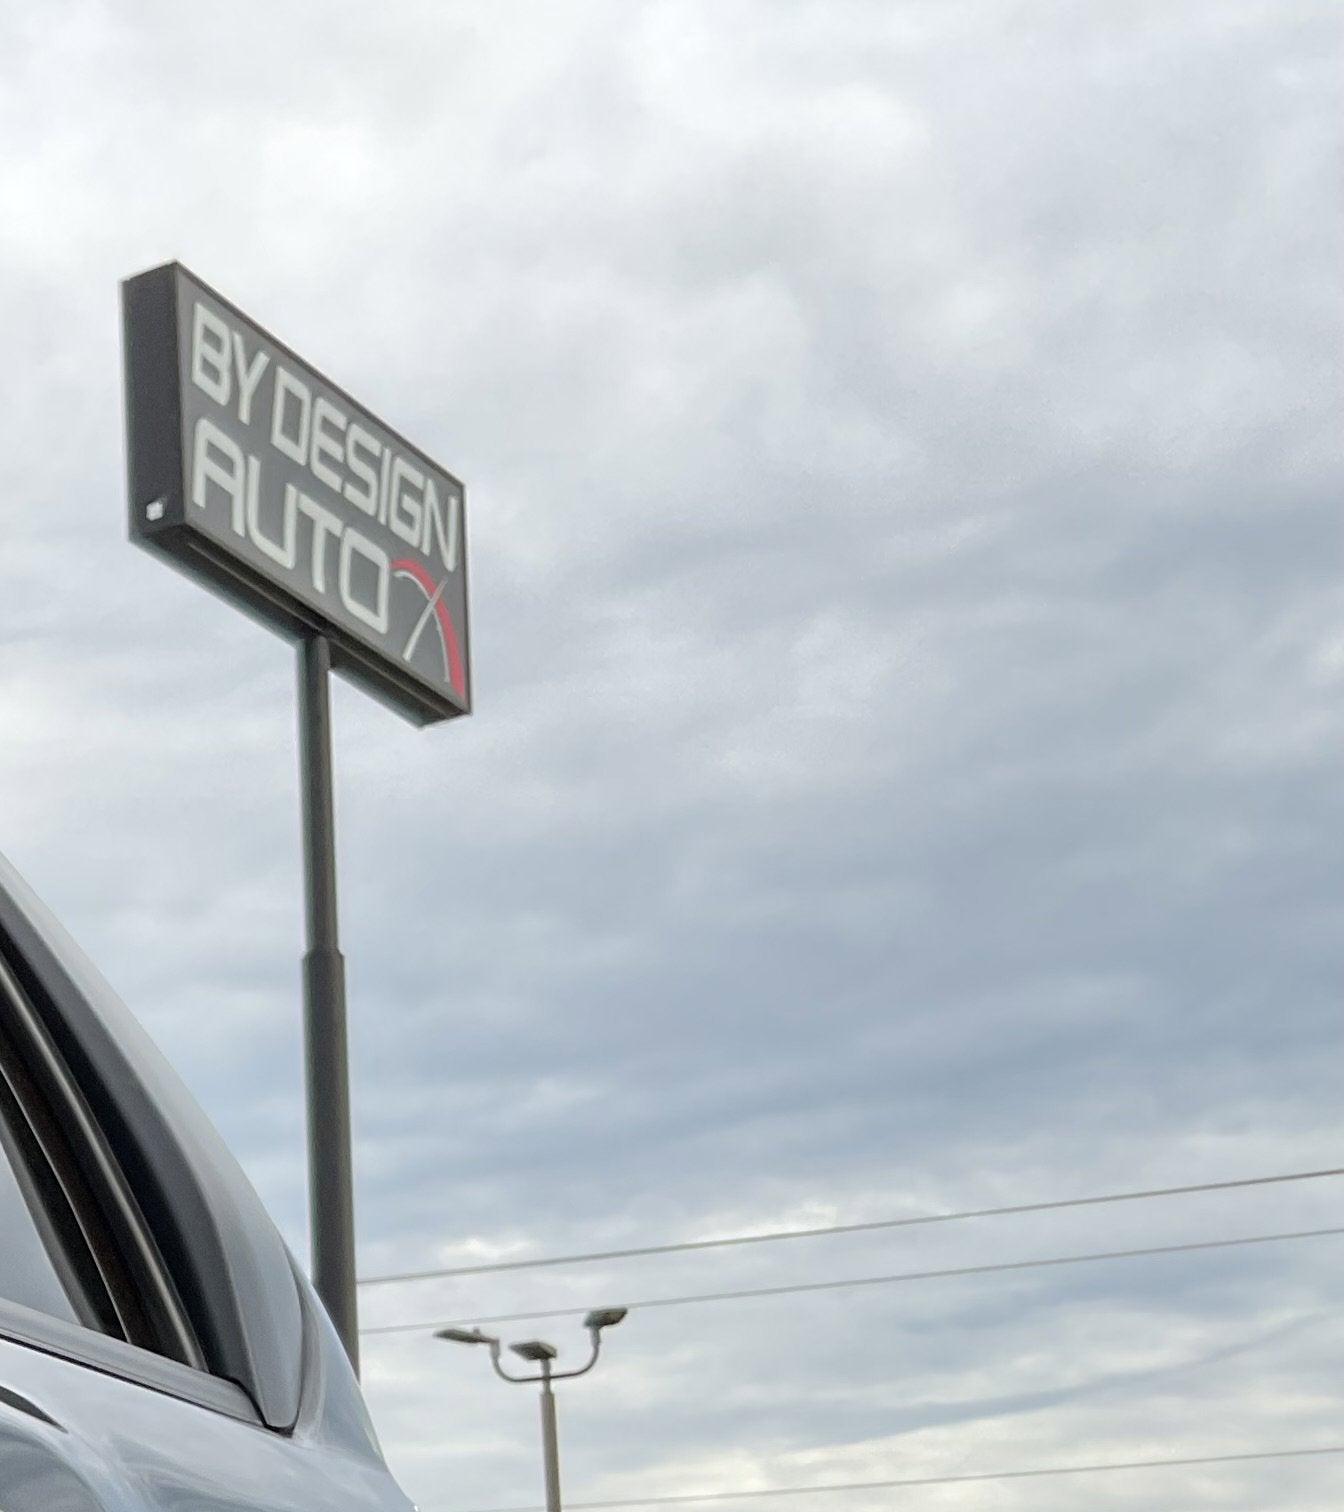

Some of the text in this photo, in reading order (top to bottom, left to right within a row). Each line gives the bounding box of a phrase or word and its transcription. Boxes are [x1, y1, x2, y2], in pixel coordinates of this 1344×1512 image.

[190, 301, 458, 573] BY DESIGN
[191, 416, 391, 634] AUTO
